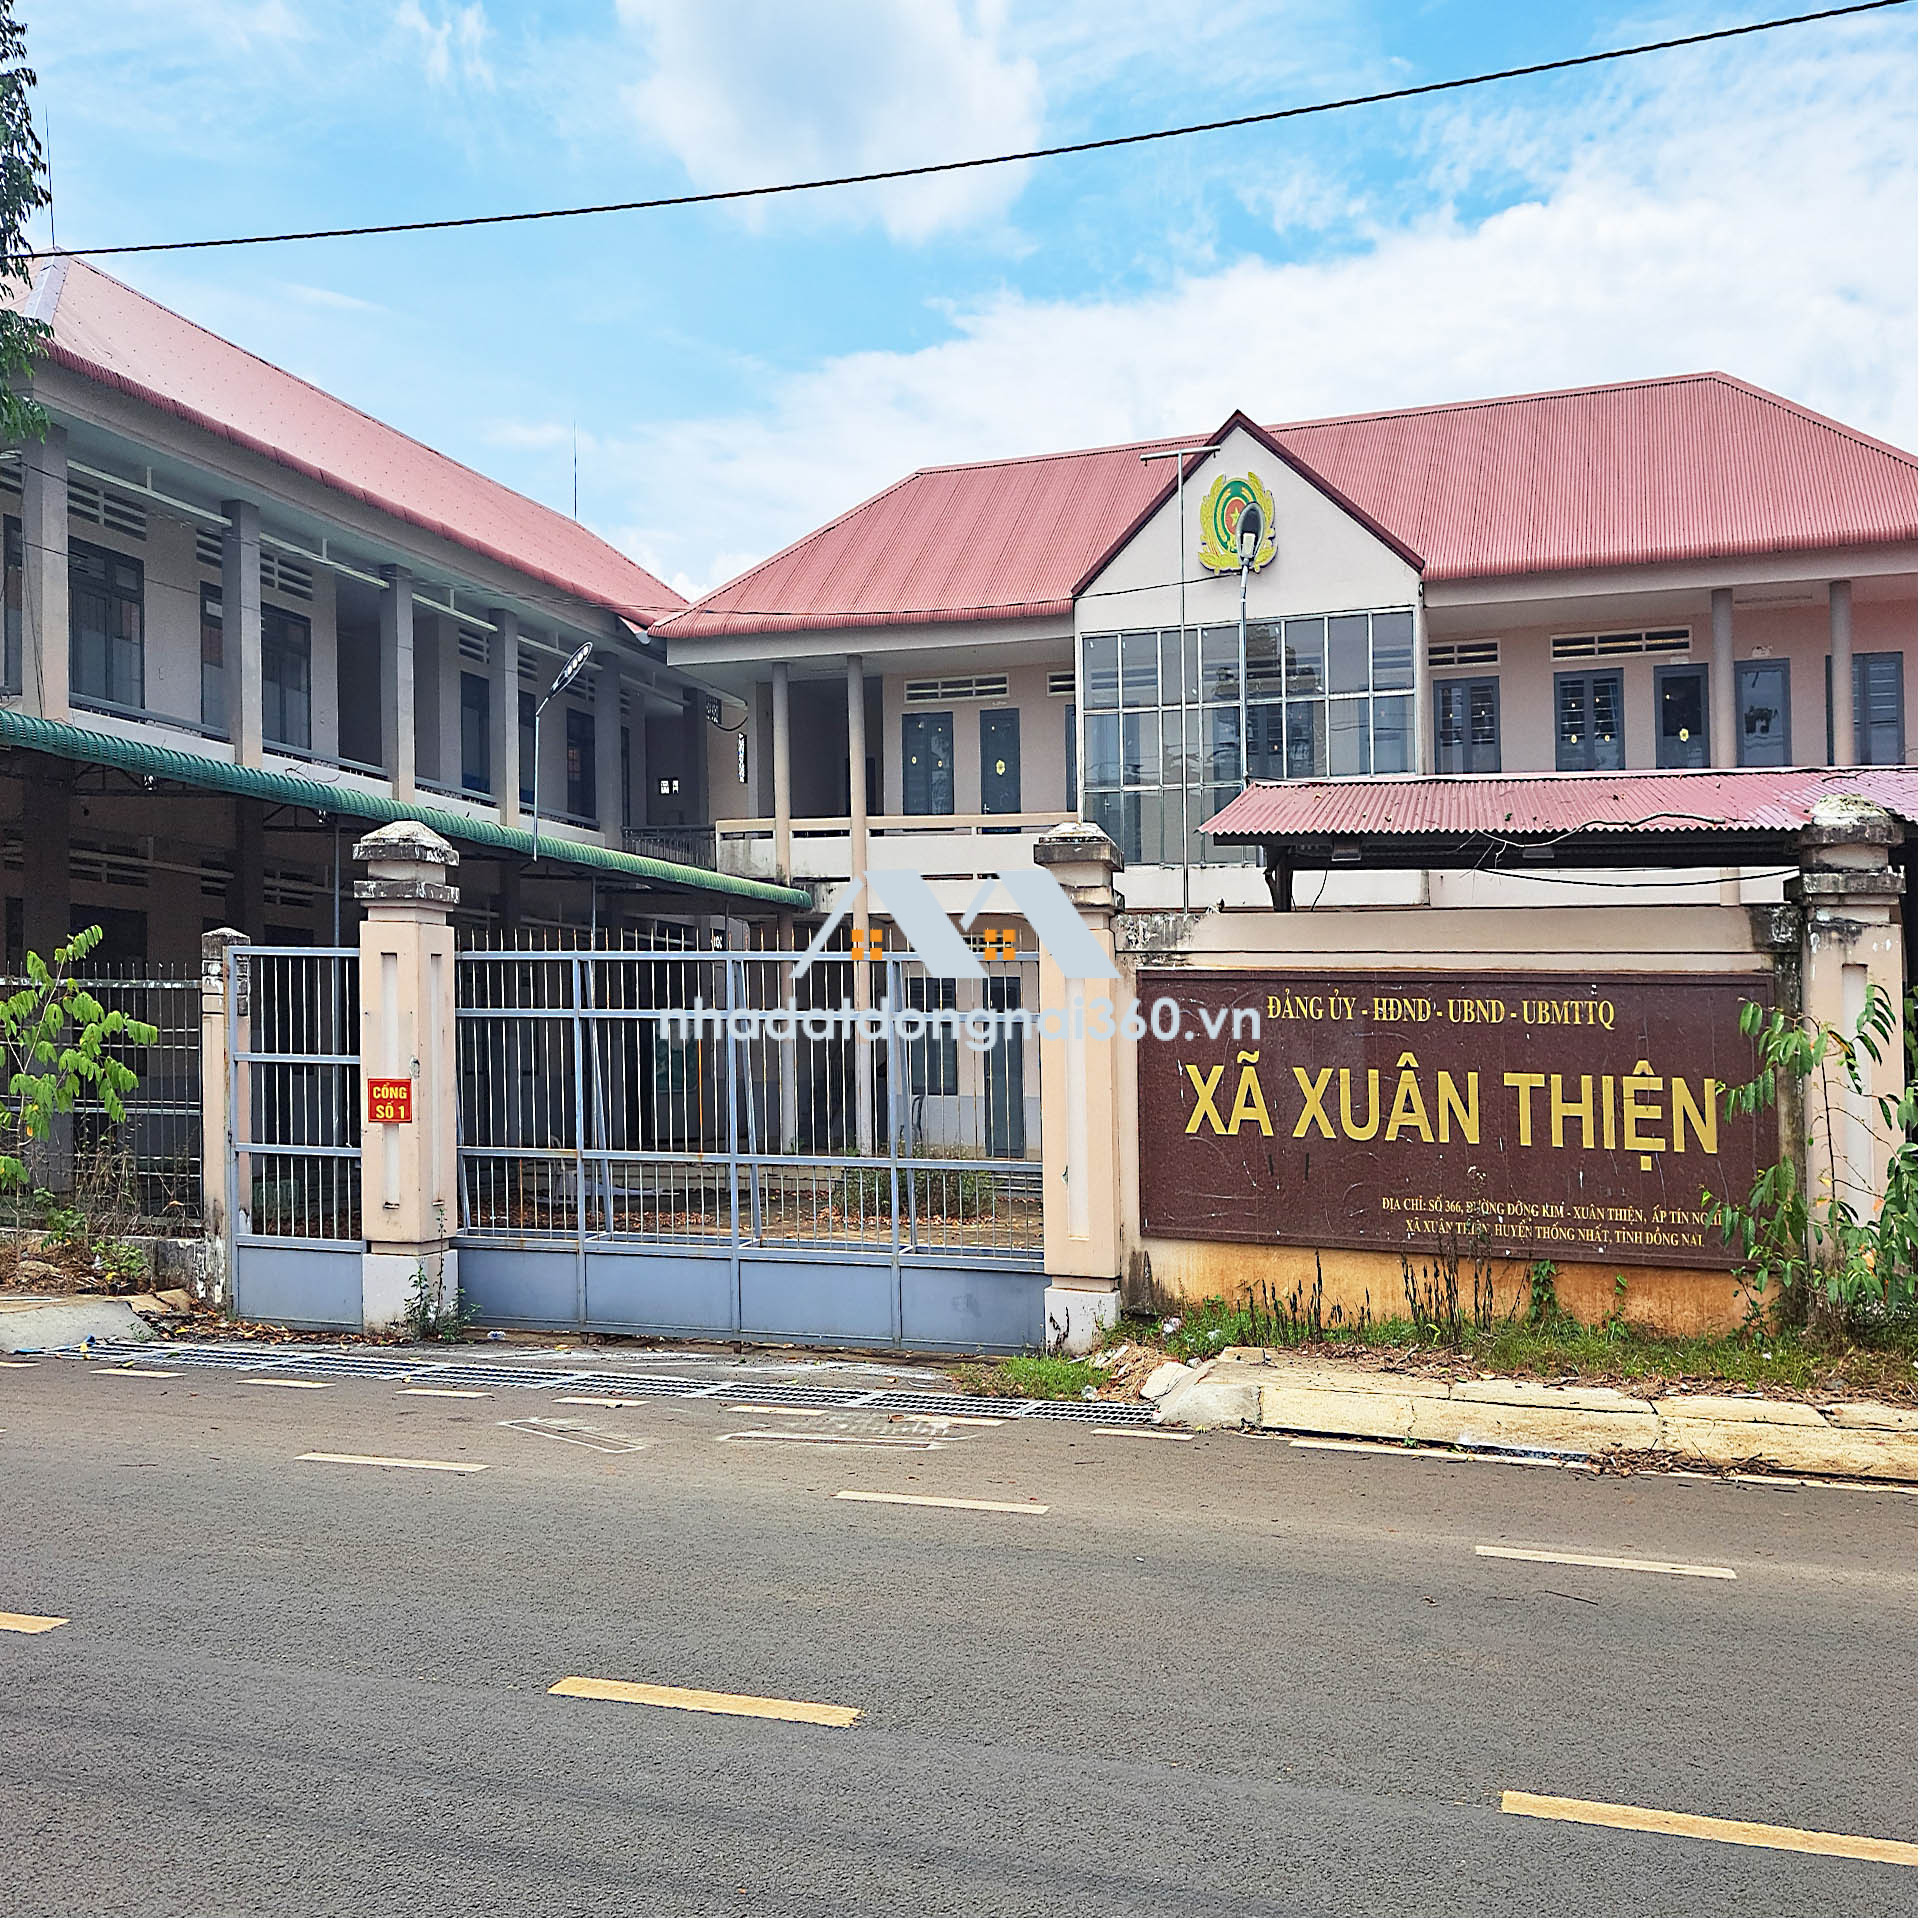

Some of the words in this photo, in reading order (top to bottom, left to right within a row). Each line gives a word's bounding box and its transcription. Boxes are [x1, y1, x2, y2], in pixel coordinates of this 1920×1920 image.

[1267, 988, 1324, 1020] ĐẢNG
[1328, 988, 1357, 1021] ỦY
[1373, 997, 1431, 1022] HĐND
[1447, 998, 1505, 1024] UBND
[1522, 1000, 1615, 1030] UBMTTQ
[373, 1082, 407, 1099] CỔNG
[375, 1100, 394, 1119] SỐ
[398, 1105, 405, 1119] 1
[1185, 1049, 1274, 1137] XÃ
[1292, 1051, 1480, 1144] XUÂN
[1503, 1060, 1718, 1171] THIỆN
[1382, 1197, 1401, 1213] ĐỊA
[1445, 1200, 1464, 1215] 366,
[1542, 1204, 1565, 1218] KIM
[1572, 1203, 1605, 1220] XUÂN
[1669, 1207, 1689, 1224] TÍN
[1406, 1216, 1421, 1233] XÃ
[1535, 1221, 1575, 1241] THỐNG
[1577, 1223, 1613, 1245] NHẤT,
